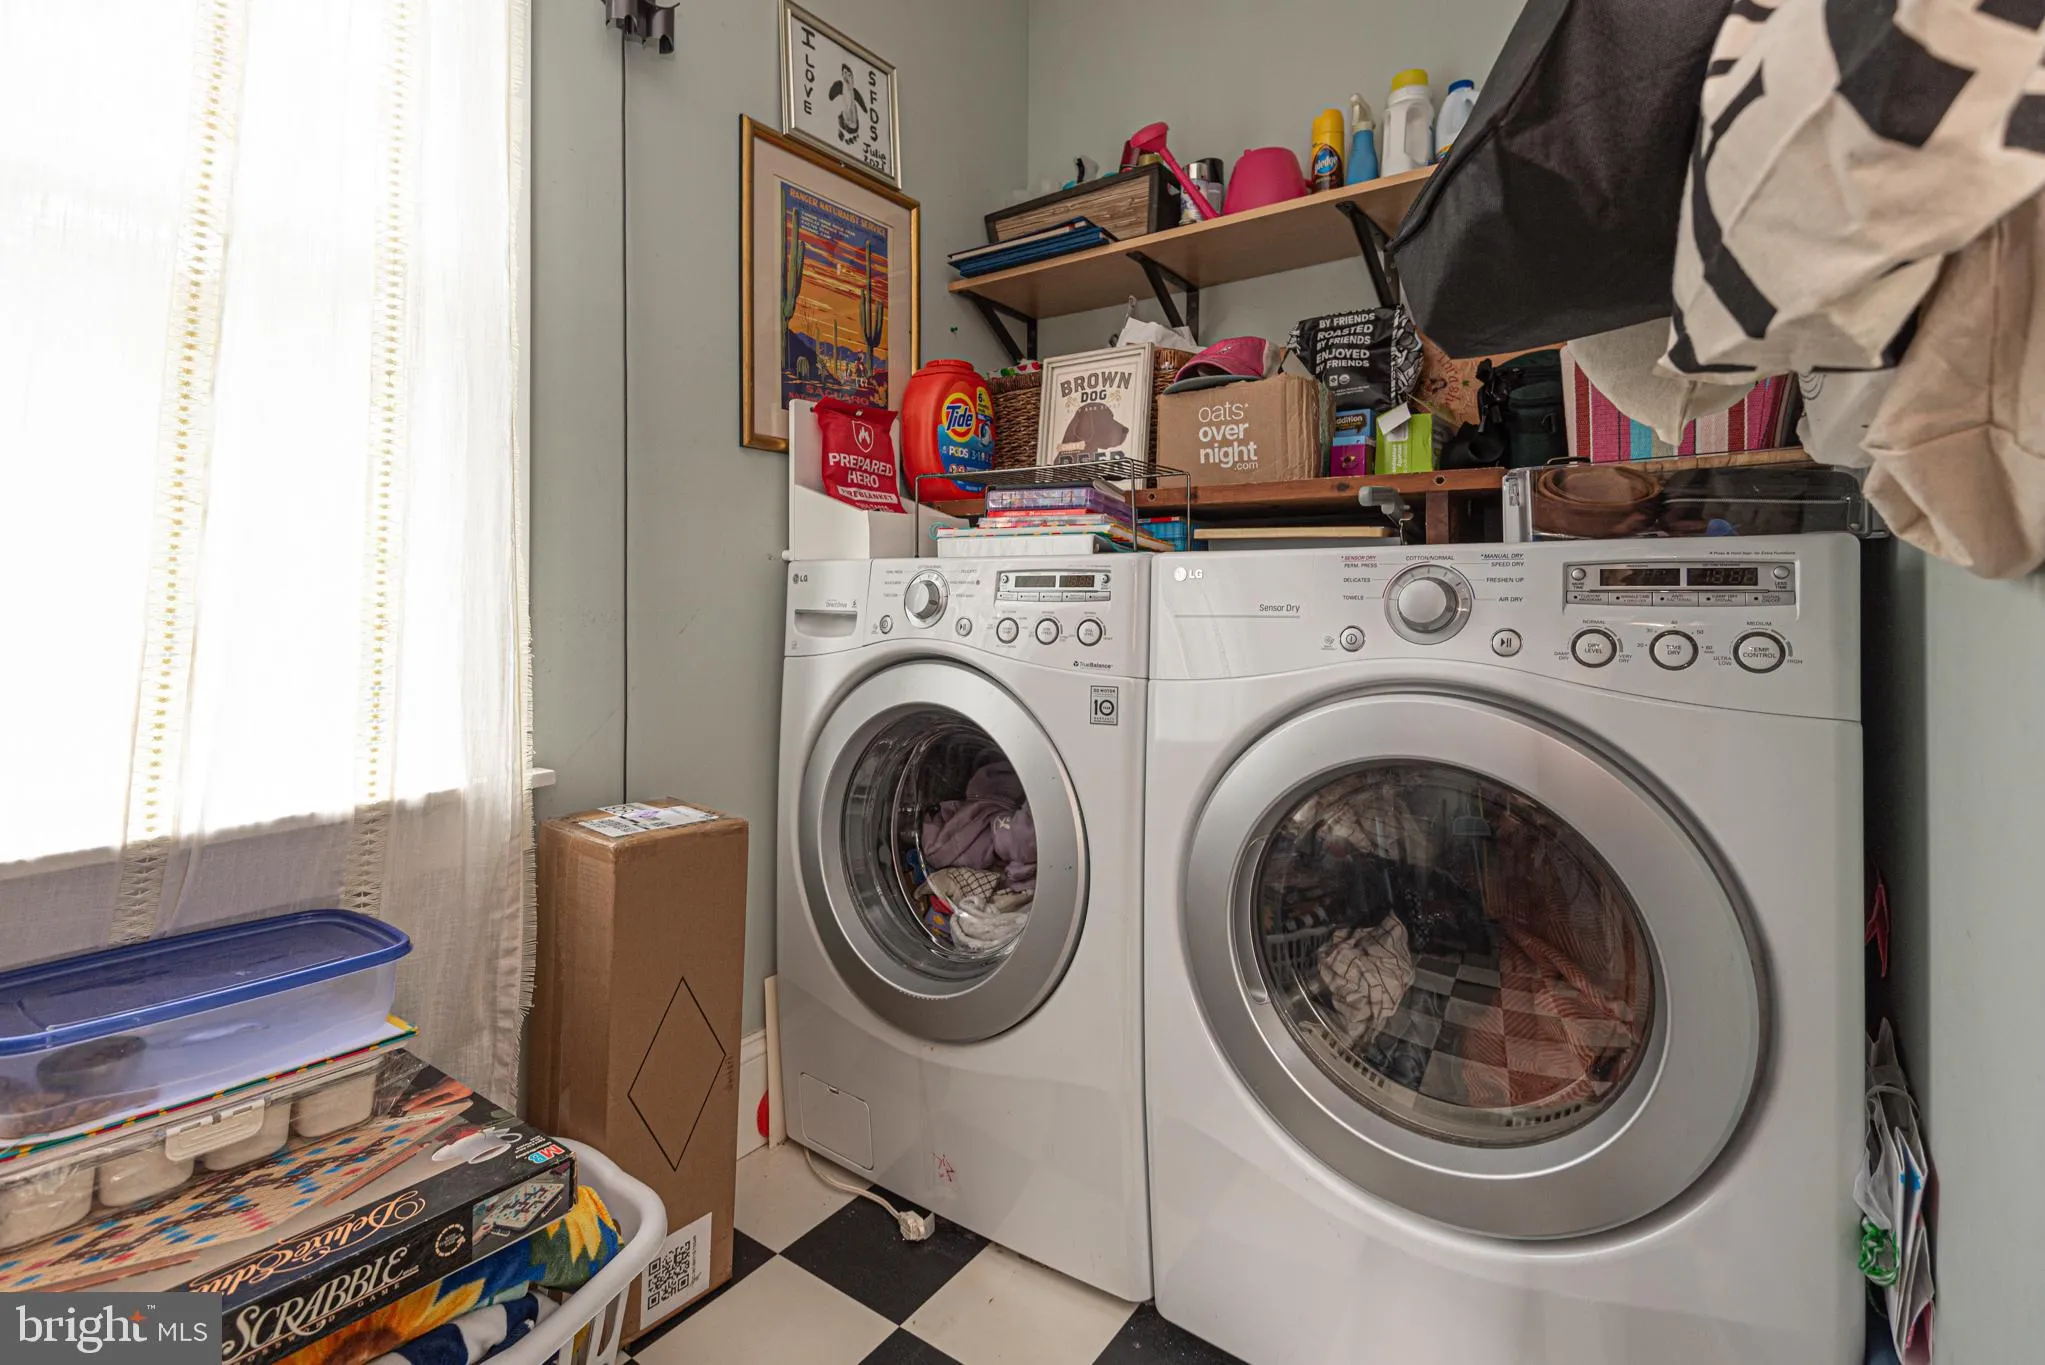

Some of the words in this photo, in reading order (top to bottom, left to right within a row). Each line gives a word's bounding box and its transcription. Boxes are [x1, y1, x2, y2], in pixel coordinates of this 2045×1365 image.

[789, 188, 818, 209] RANGER
[820, 202, 857, 224] NATURALIST
[861, 218, 886, 237] SERVICE
[1319, 319, 1331, 329] BY
[1333, 312, 1376, 326] FRIENDS
[1317, 324, 1374, 341] ROASTED
[1317, 340, 1327, 351] BY
[1328, 336, 1371, 346] FRIENDS
[1316, 348, 1370, 363] ENJOYED
[1316, 364, 1325, 374] BY
[1326, 359, 1370, 369] FRIENDS
[1060, 371, 1132, 398] BROWN
[1080, 389, 1107, 403] DOG
[945, 403, 974, 432] Tide
[1199, 402, 1245, 423] oats
[1199, 423, 1249, 442] over
[949, 445, 969, 459] PODS
[1200, 441, 1257, 468] night
[828, 452, 893, 477] PREPARED
[1234, 462, 1258, 471] .com
[847, 470, 879, 488] HERO
[1189, 569, 1203, 579] LG
[1259, 603, 1285, 612] Sensor
[1286, 604, 1300, 614] Dry
[1094, 699, 1115, 716] 10
[291, 1190, 426, 1263] Deluxe
[357, 1282, 401, 1308] GAME
[222, 1246, 409, 1364] SCRABBLE
